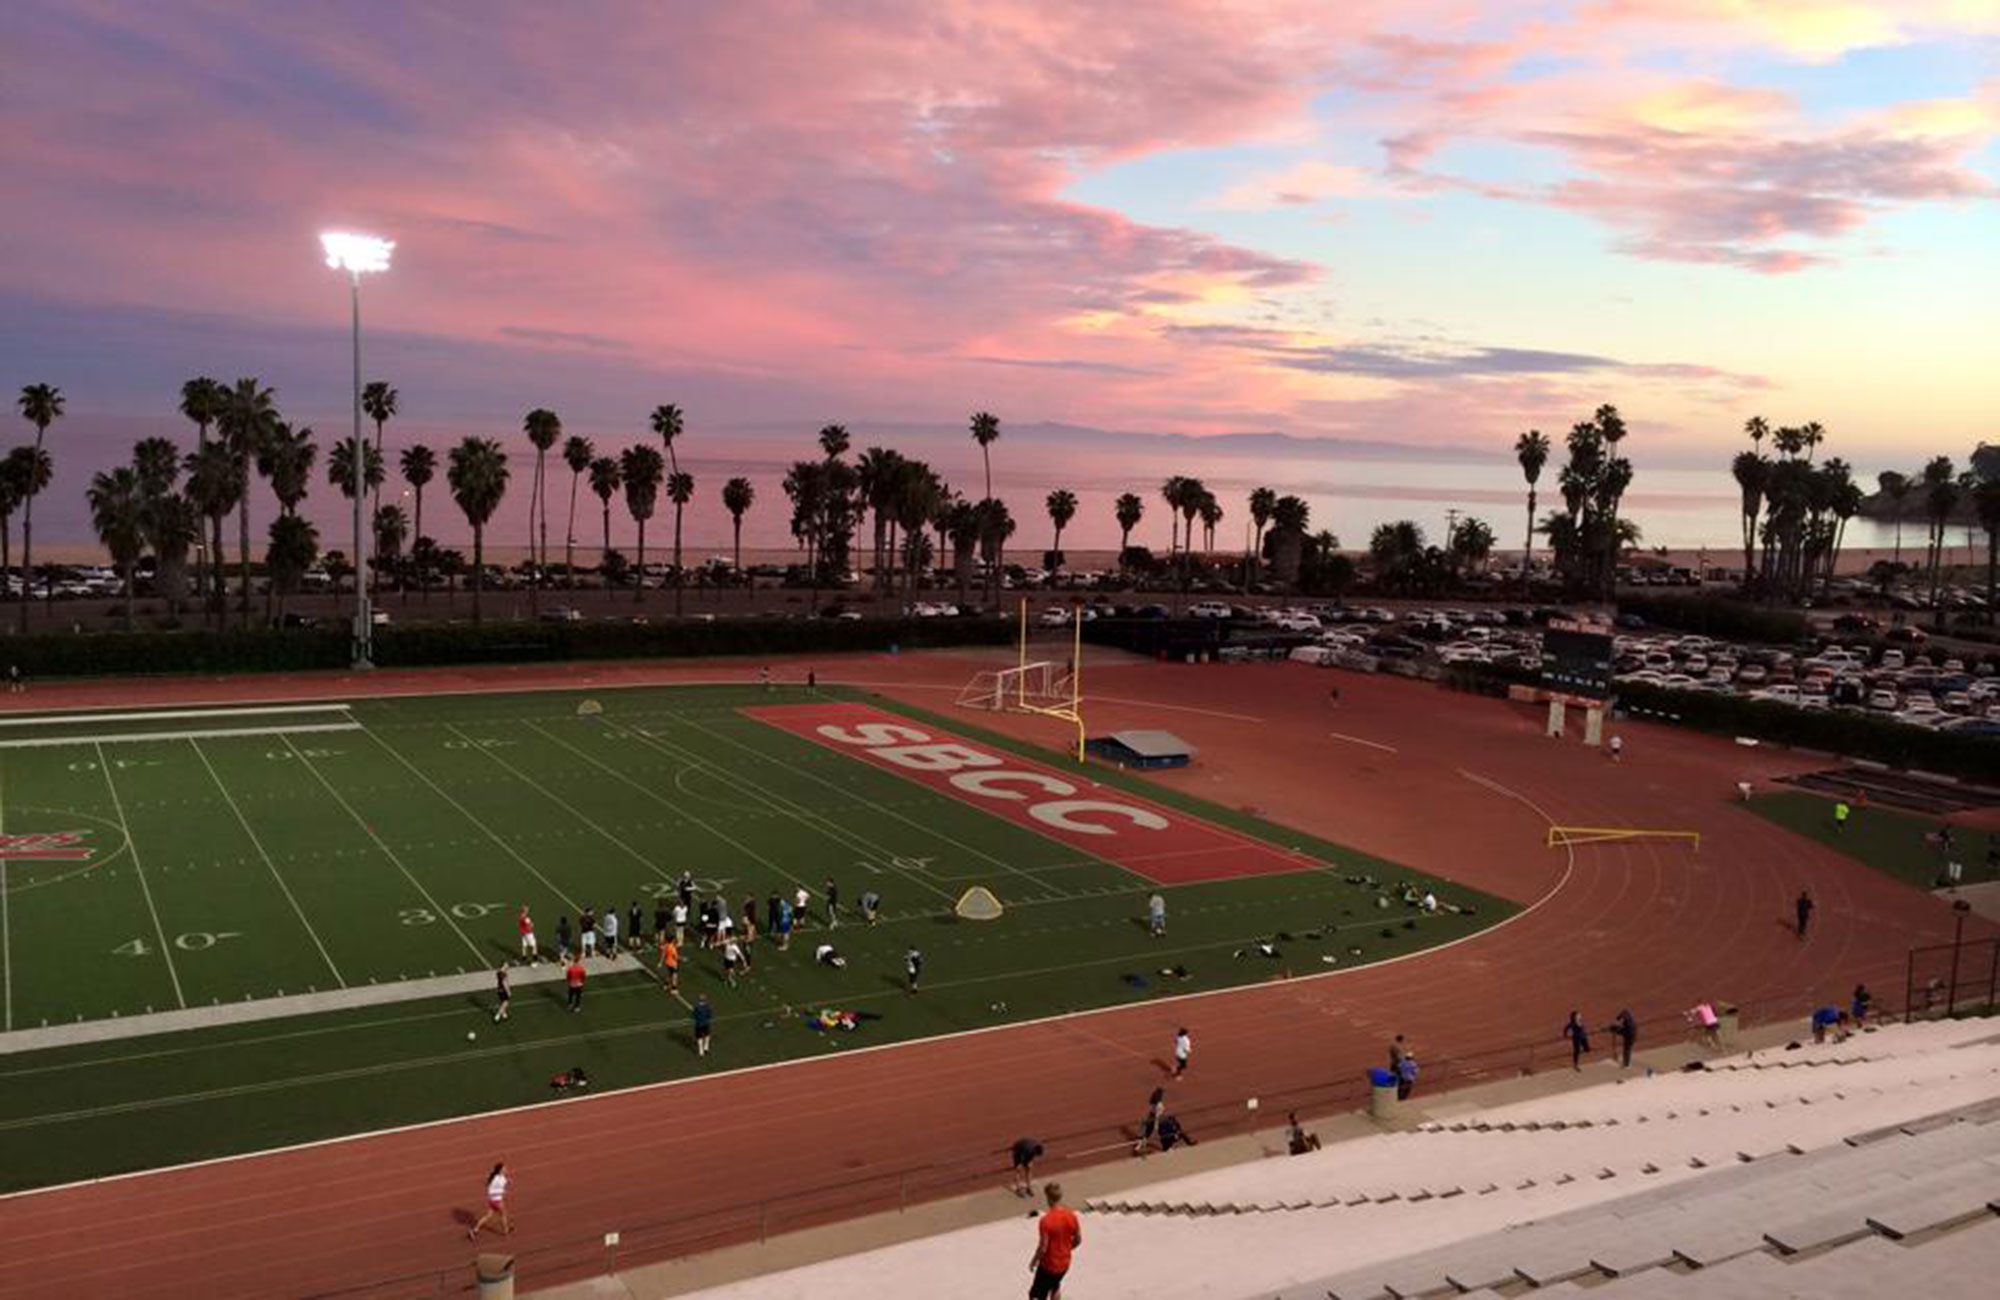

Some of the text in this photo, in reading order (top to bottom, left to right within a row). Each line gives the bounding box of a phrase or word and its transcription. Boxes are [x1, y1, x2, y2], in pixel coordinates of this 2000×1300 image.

[816, 723, 1169, 835] SBCC
[399, 902, 489, 926] 30
[111, 932, 216, 955] 40
